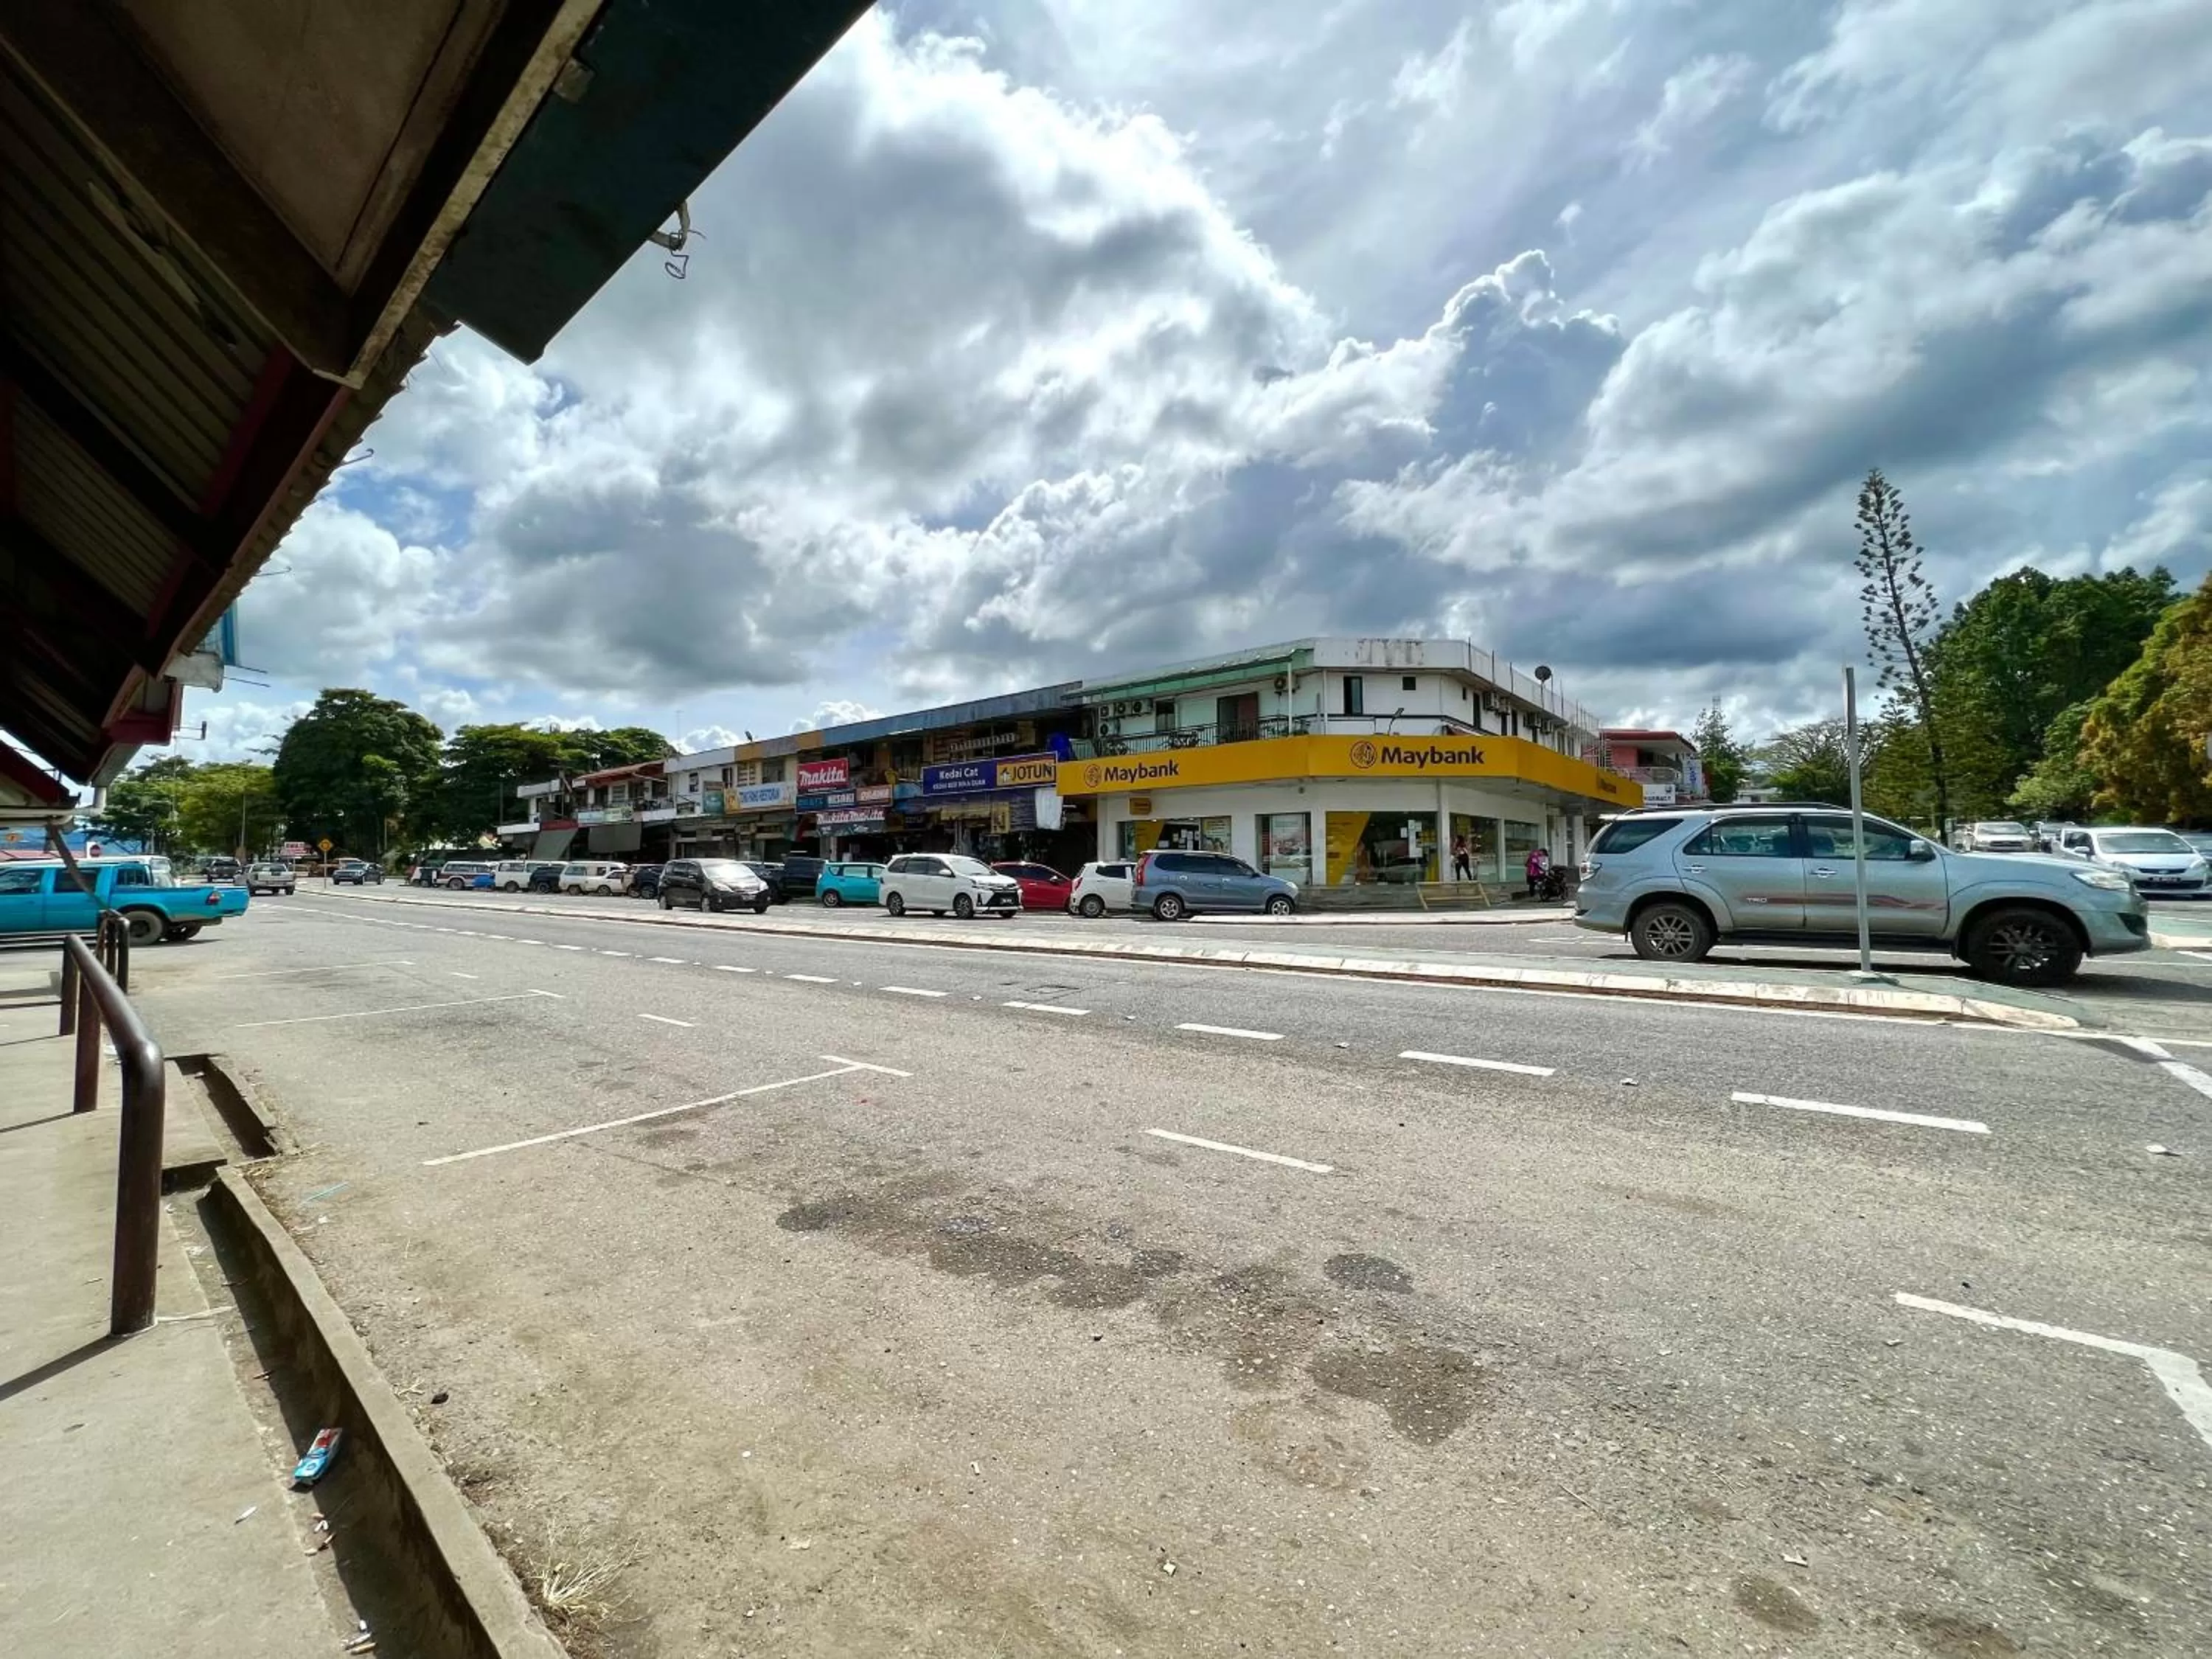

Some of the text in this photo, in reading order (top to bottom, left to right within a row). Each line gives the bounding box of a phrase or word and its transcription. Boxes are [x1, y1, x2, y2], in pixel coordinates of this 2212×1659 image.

[1380, 746, 1485, 768] Maybank
[939, 767, 979, 779] Kedai Cat
[1012, 762, 1053, 781] JOTUN
[1105, 759, 1180, 783] Maybank
